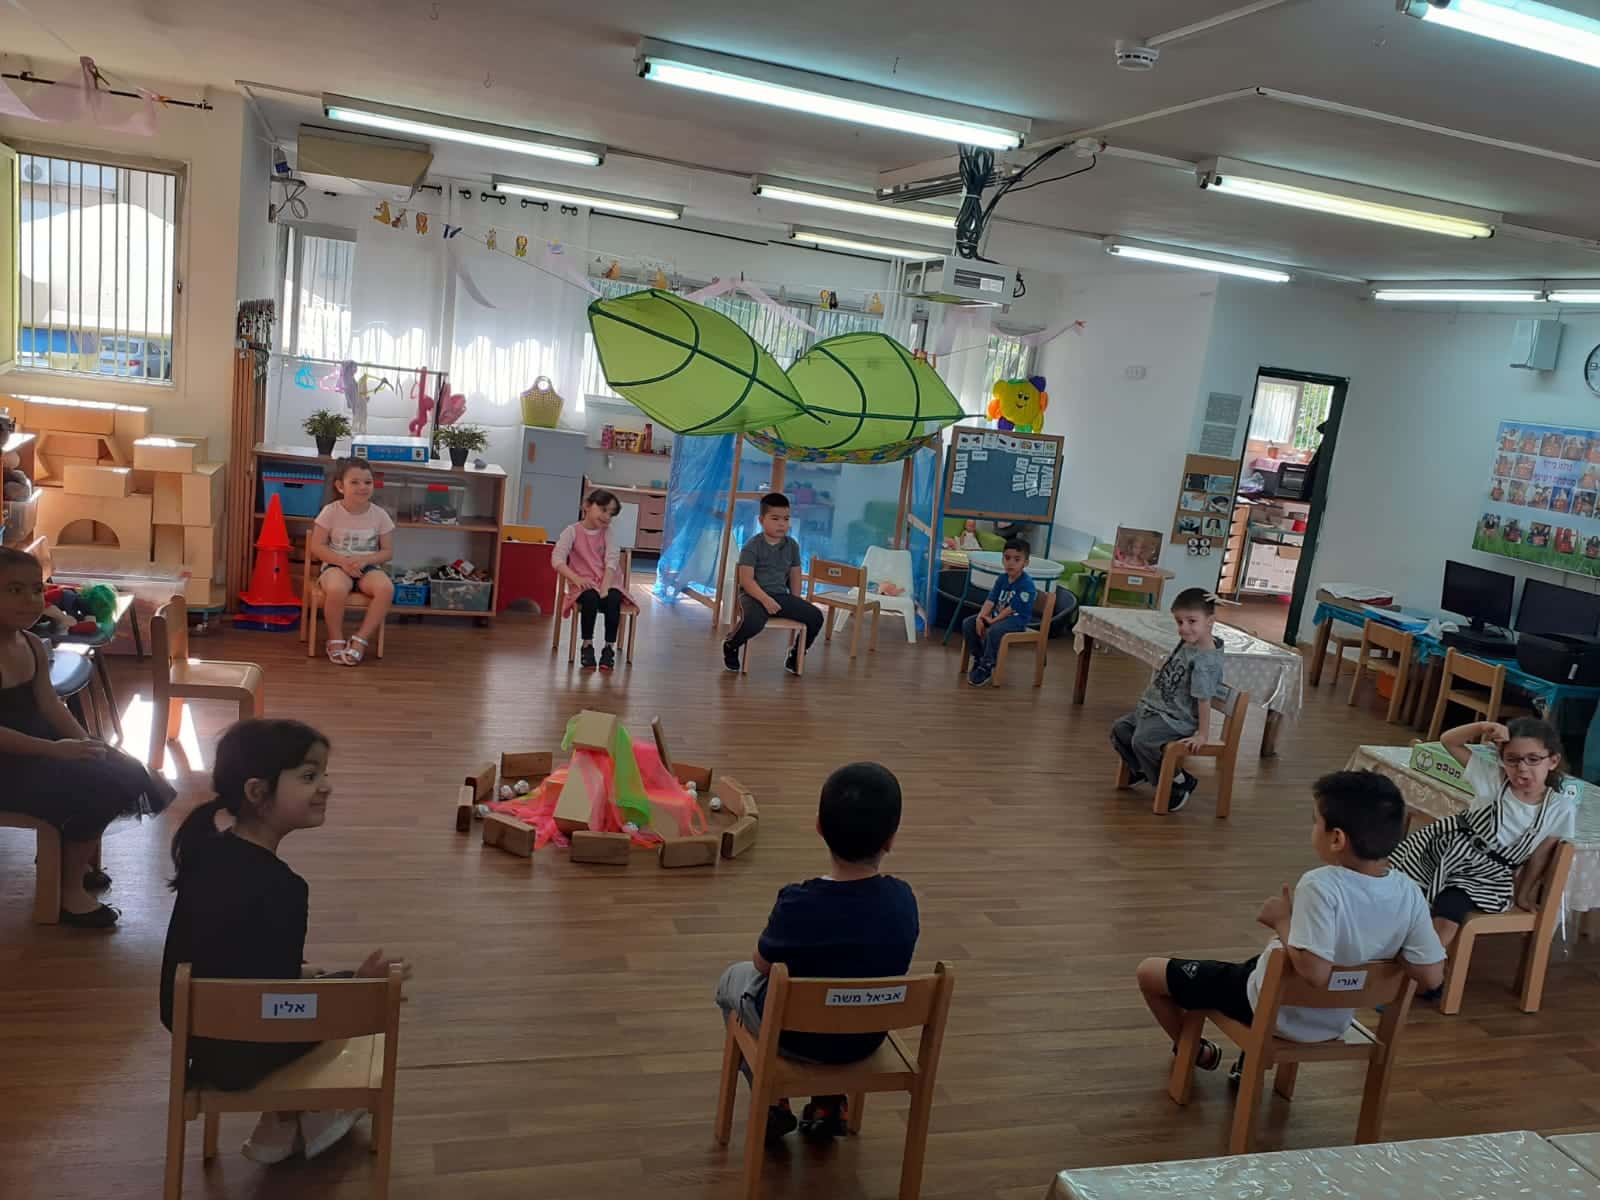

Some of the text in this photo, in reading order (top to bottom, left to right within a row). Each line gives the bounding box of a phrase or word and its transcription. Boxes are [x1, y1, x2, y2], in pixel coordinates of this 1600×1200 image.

[1336, 977, 1359, 986] אורי
[832, 991, 901, 1003] אביאל משה
[273, 1001, 305, 1017] אלין
